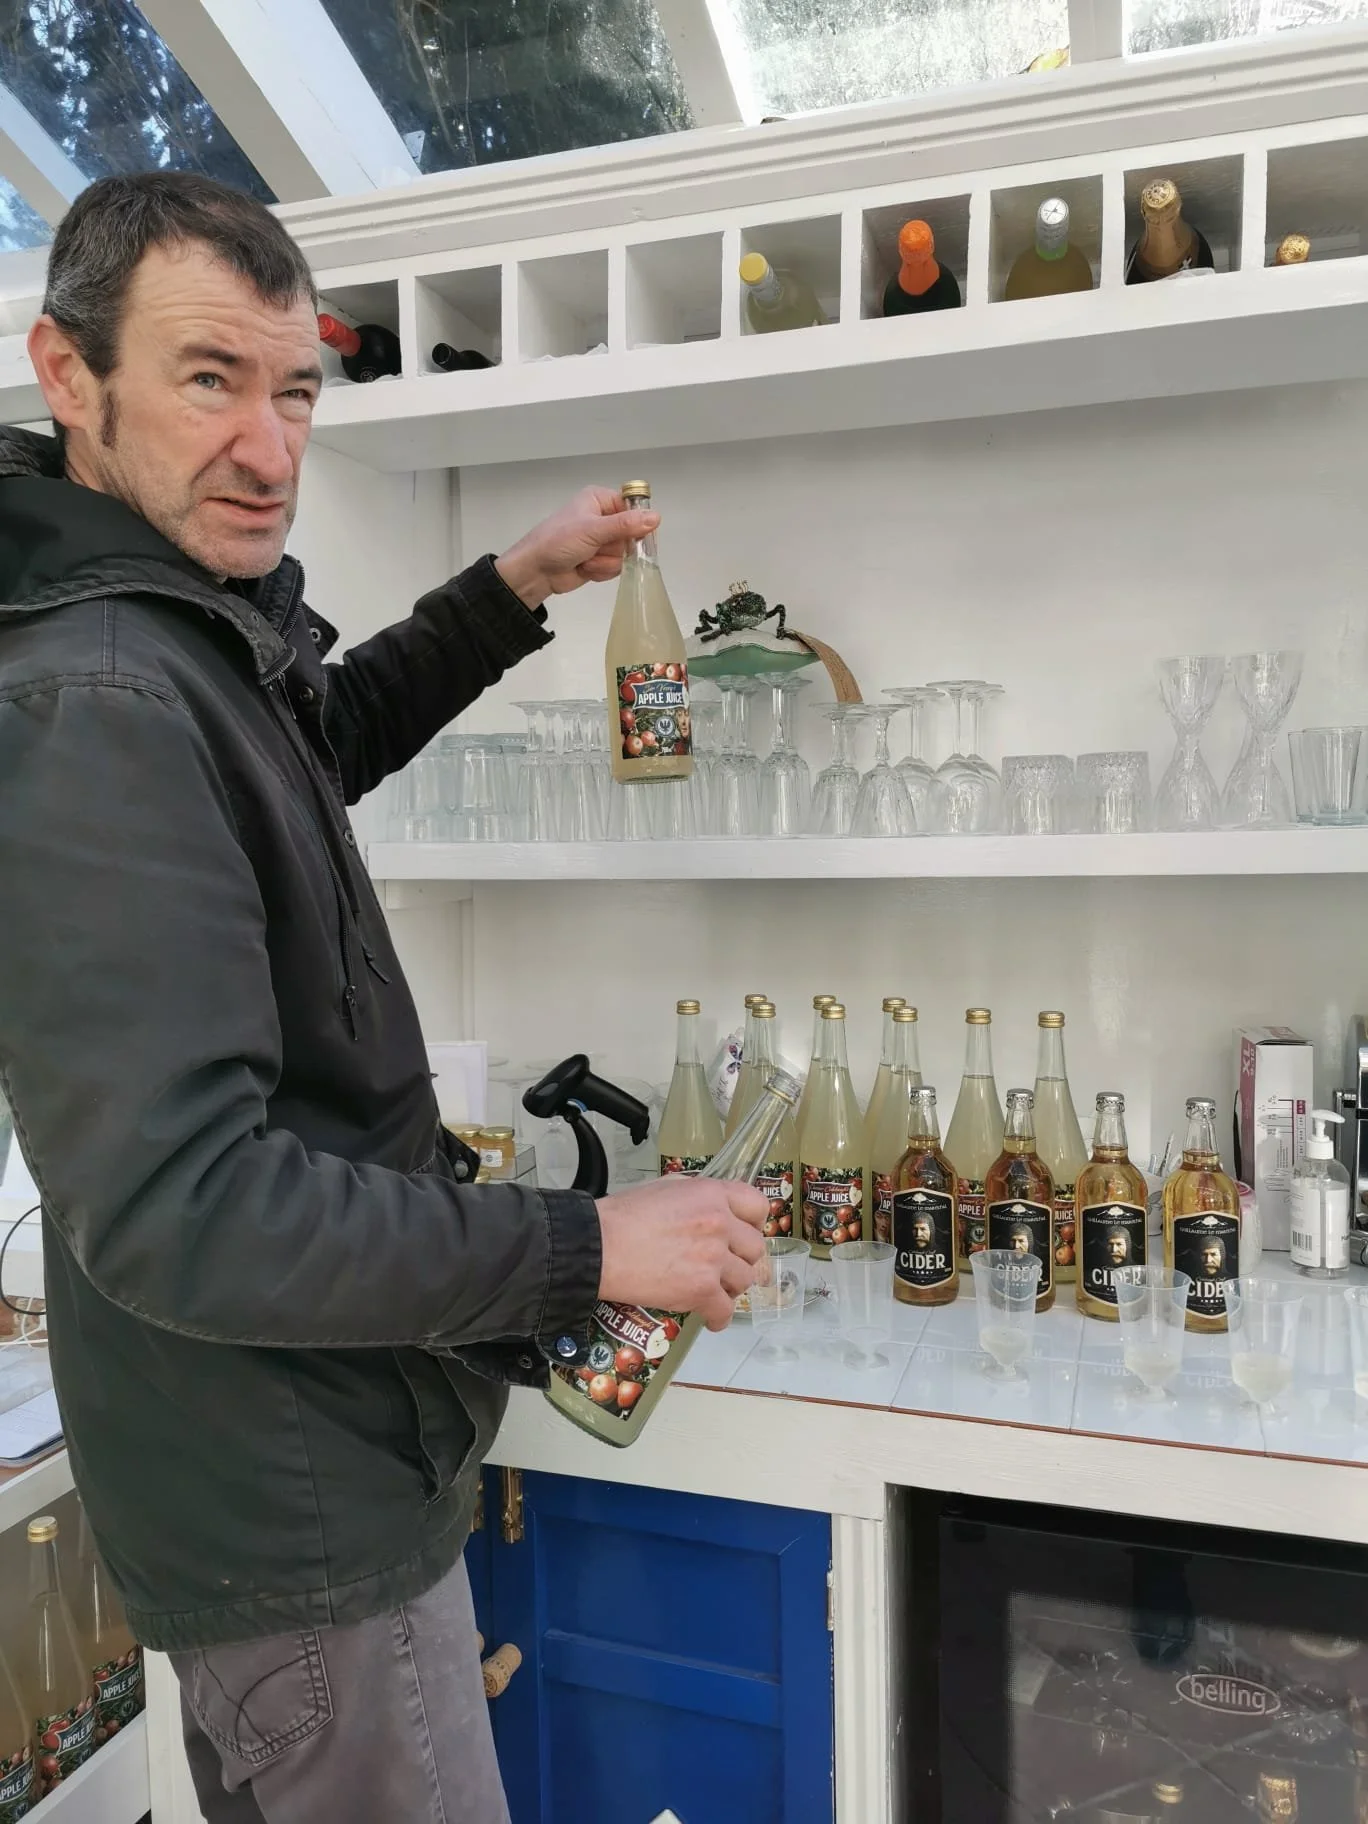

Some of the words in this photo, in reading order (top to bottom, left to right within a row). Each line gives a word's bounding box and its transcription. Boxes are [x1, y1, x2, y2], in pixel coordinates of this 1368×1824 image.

[638, 692, 664, 705] APPLE
[666, 692, 682, 704] JUICE
[810, 1190, 829, 1202] APPLE
[830, 1193, 849, 1203] JUICE
[959, 1203, 980, 1215] APPLE
[900, 1251, 946, 1270] CIDER
[1091, 1267, 1142, 1286] CIDER
[595, 1302, 623, 1329] APPLE
[619, 1319, 650, 1346] JUICE
[103, 1680, 127, 1699] APPLE
[1190, 1675, 1266, 1715] belling
[62, 1727, 86, 1750] APPLE
